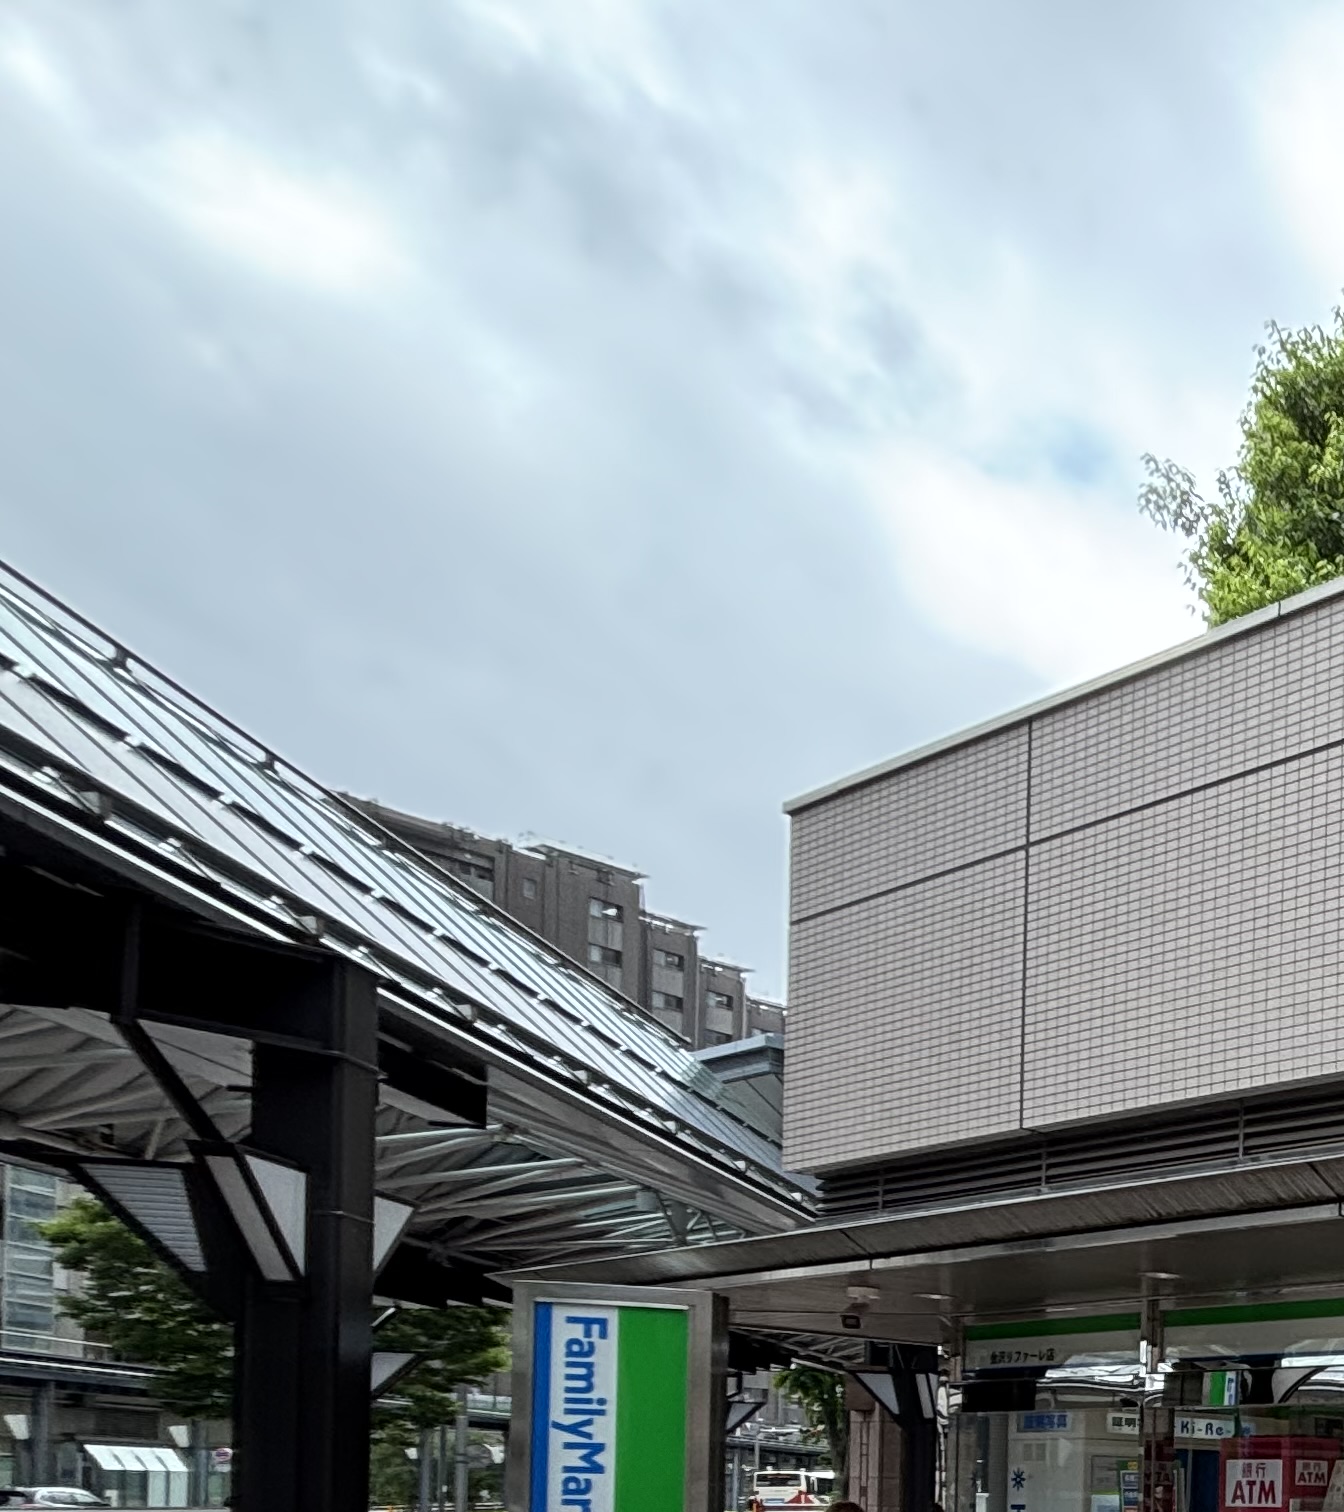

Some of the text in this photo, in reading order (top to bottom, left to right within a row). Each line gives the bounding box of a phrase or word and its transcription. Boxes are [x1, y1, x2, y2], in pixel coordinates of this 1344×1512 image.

[1111, 1416, 1139, 1429] 証明
[1241, 1462, 1267, 1479] 銀行
[1297, 1472, 1326, 1484] ATM
[1231, 1480, 1277, 1505] ATM
